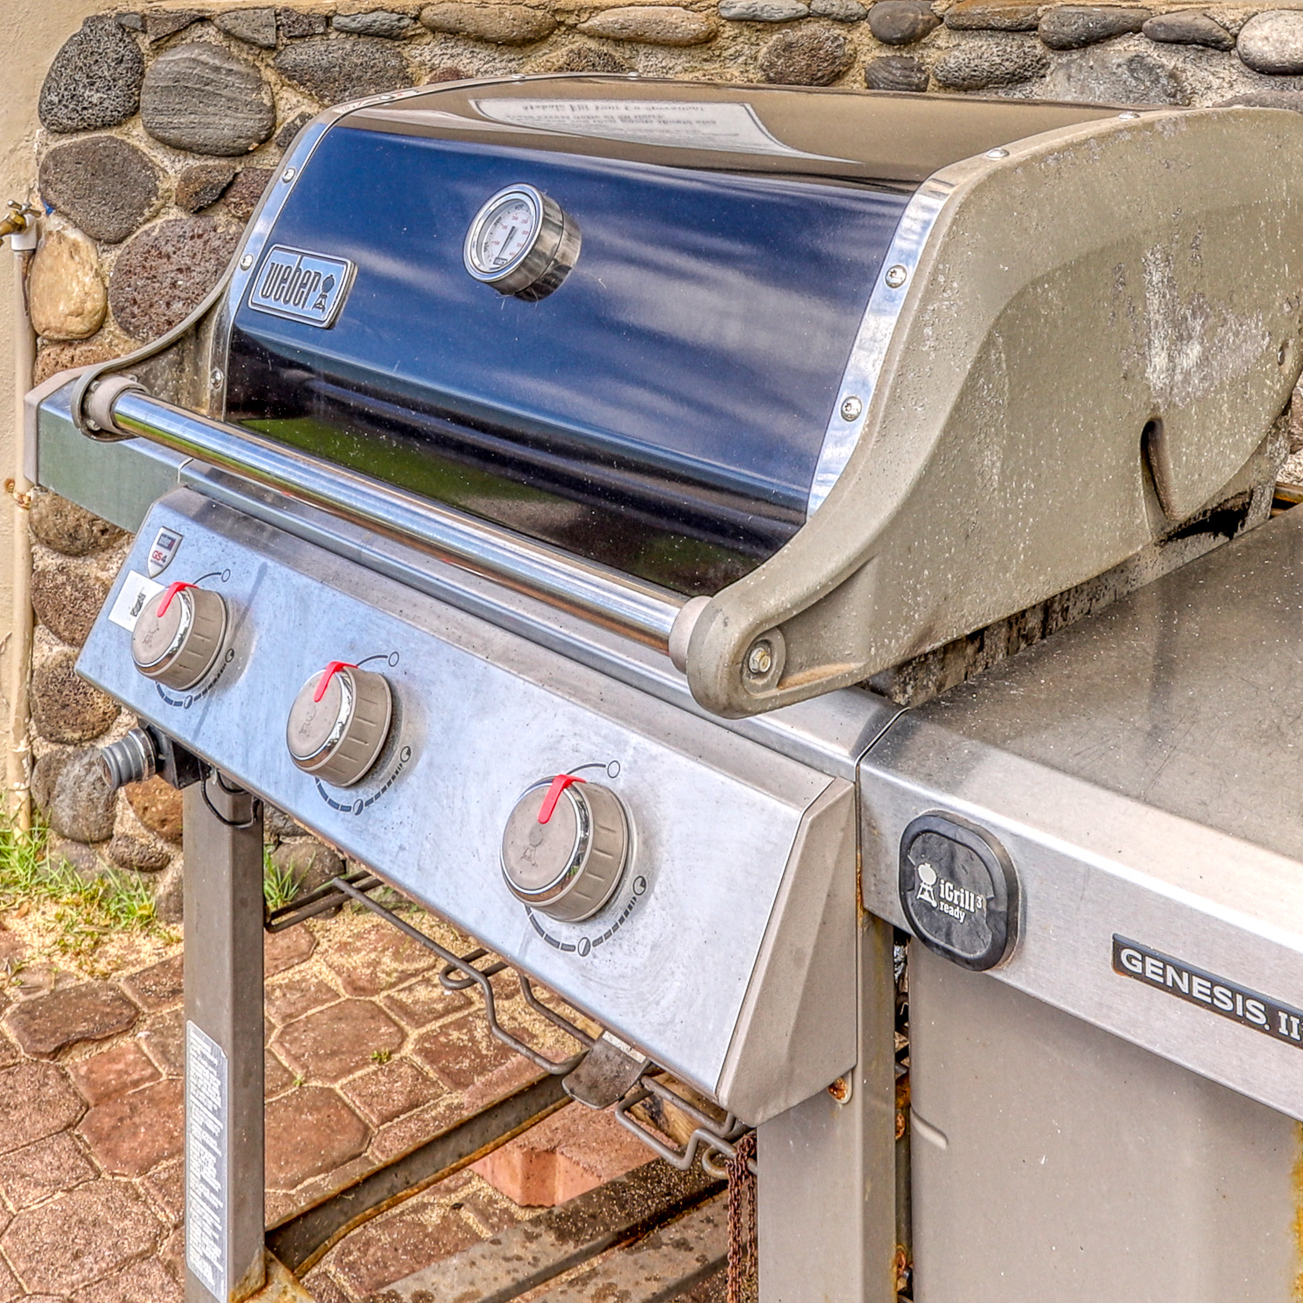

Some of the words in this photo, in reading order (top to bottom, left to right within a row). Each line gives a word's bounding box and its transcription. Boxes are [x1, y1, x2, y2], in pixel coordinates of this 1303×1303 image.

[260, 255, 322, 309] weber
[152, 550, 168, 564] GS4
[939, 901, 966, 924] ready
[1120, 948, 1268, 1026] GENESIS
[1277, 1010, 1302, 1042] II
